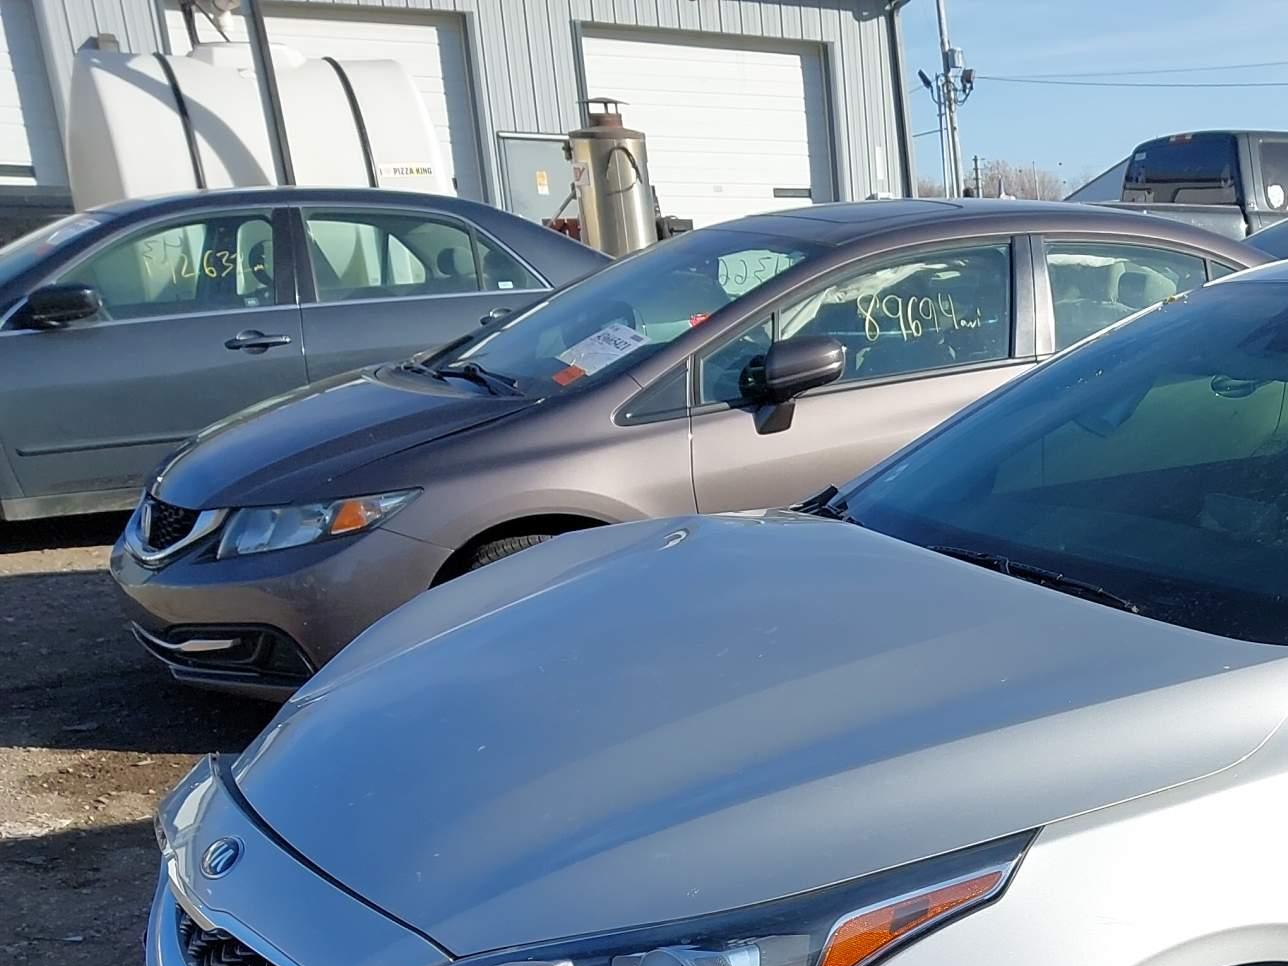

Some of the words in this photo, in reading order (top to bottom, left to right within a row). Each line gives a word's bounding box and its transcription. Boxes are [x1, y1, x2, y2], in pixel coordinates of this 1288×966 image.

[393, 167, 414, 176] PIZZA
[415, 167, 432, 175] KING
[857, 292, 959, 341] 89694
